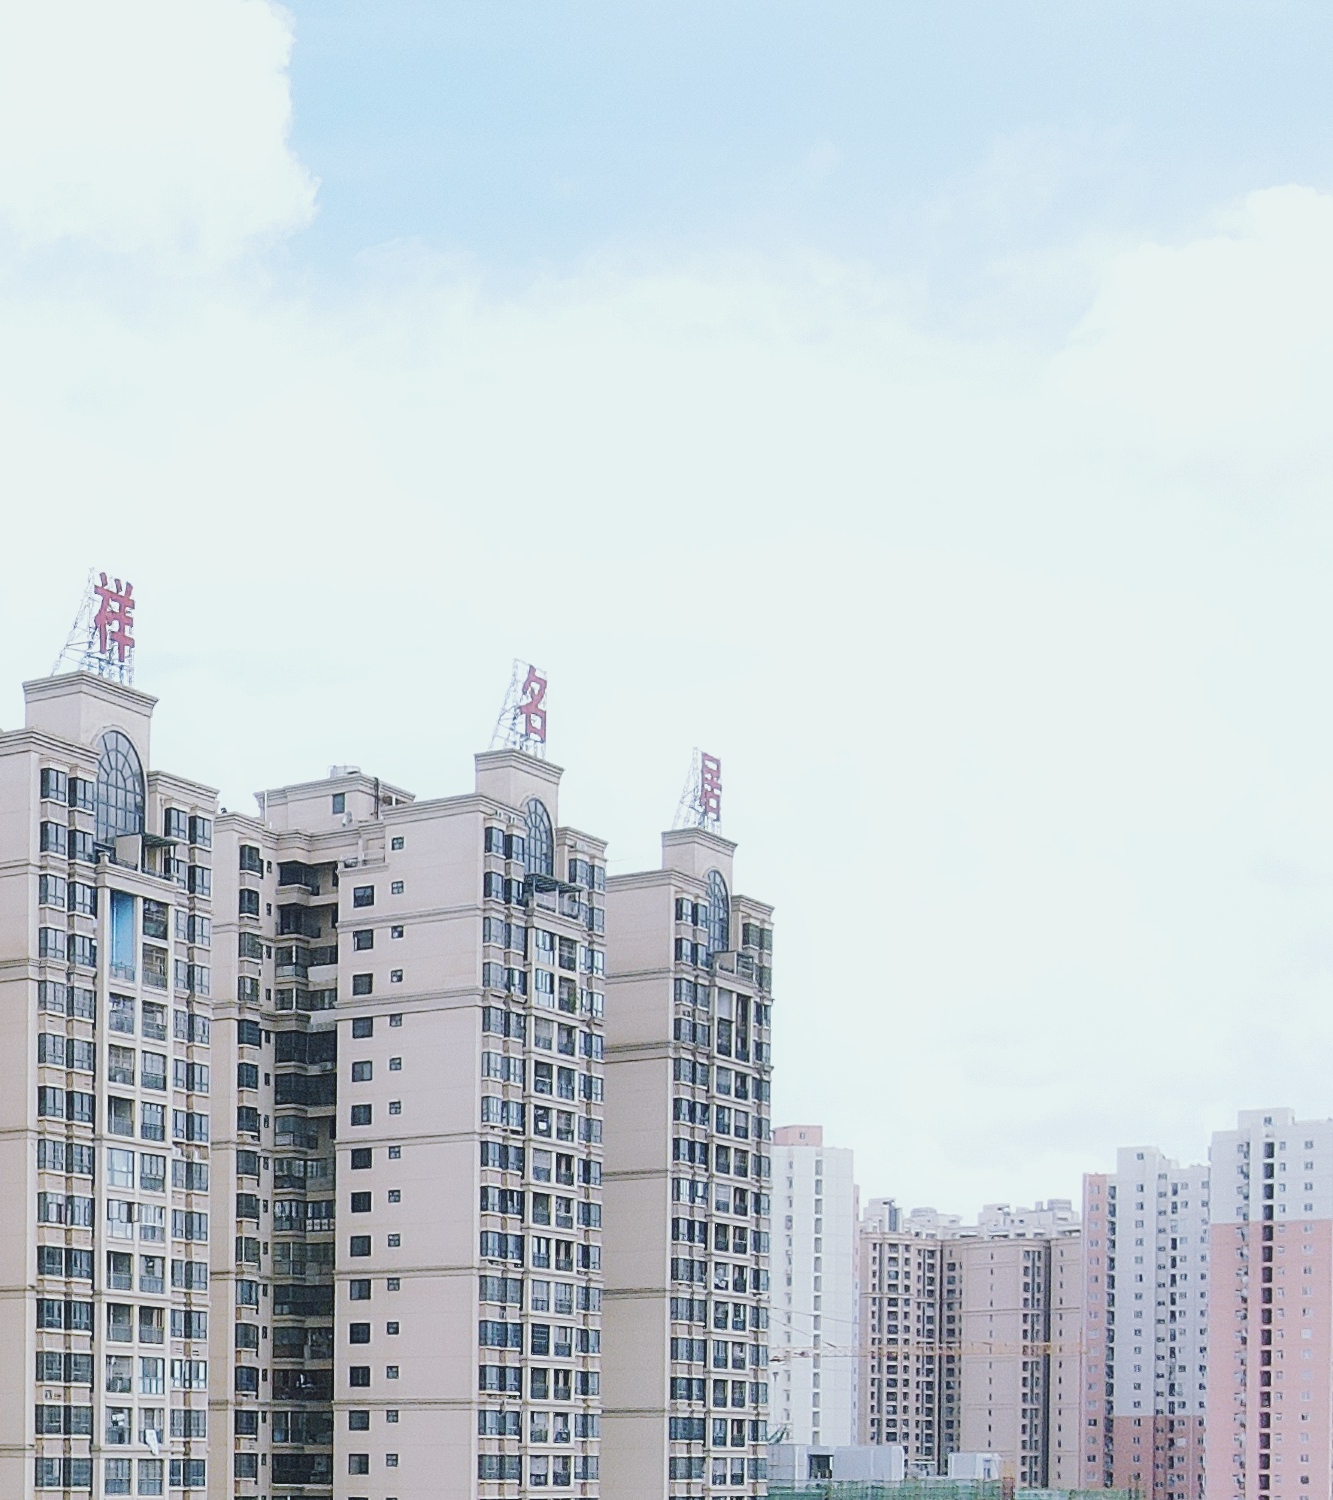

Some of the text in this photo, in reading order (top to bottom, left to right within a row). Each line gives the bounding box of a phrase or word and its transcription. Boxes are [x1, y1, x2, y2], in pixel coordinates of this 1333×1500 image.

[94, 572, 135, 662] 祥
[520, 665, 547, 742] 名
[700, 752, 722, 821] 居
